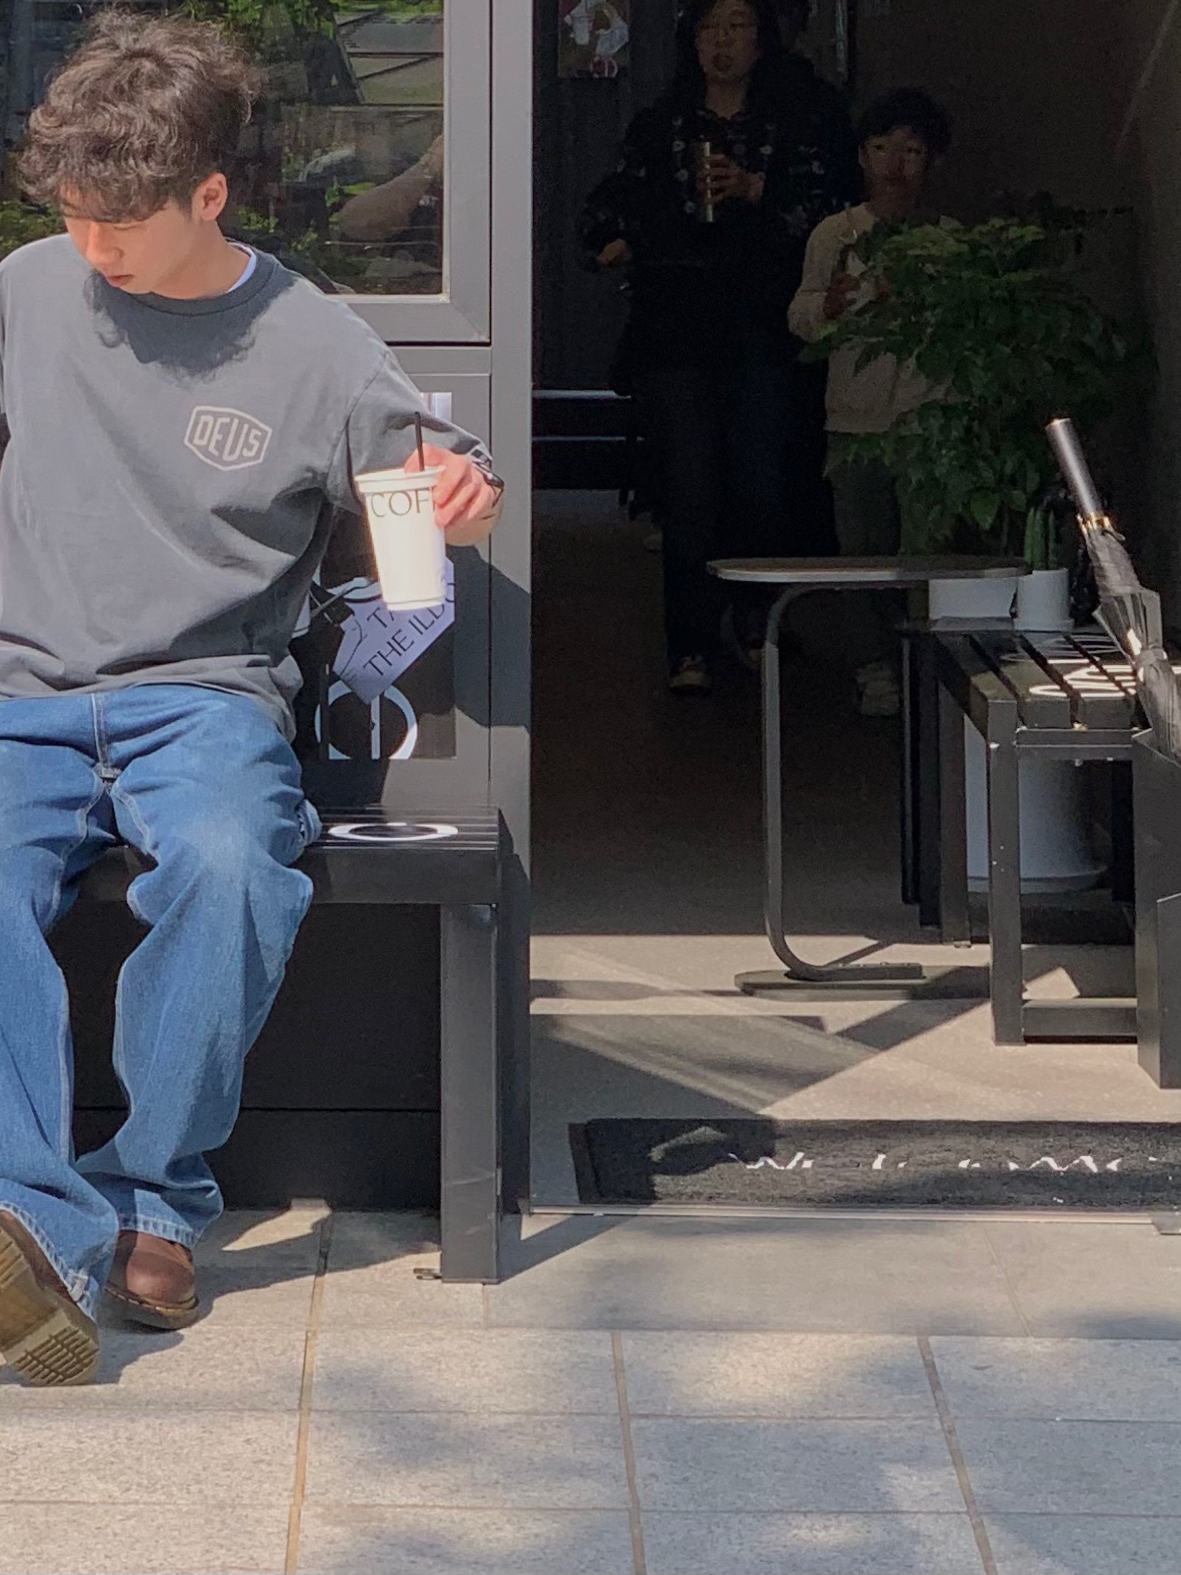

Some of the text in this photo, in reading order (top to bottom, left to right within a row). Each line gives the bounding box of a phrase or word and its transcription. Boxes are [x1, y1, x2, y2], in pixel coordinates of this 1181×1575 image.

[193, 414, 262, 462] DEUS
[370, 487, 436, 518] COF
[362, 628, 415, 676] THE
